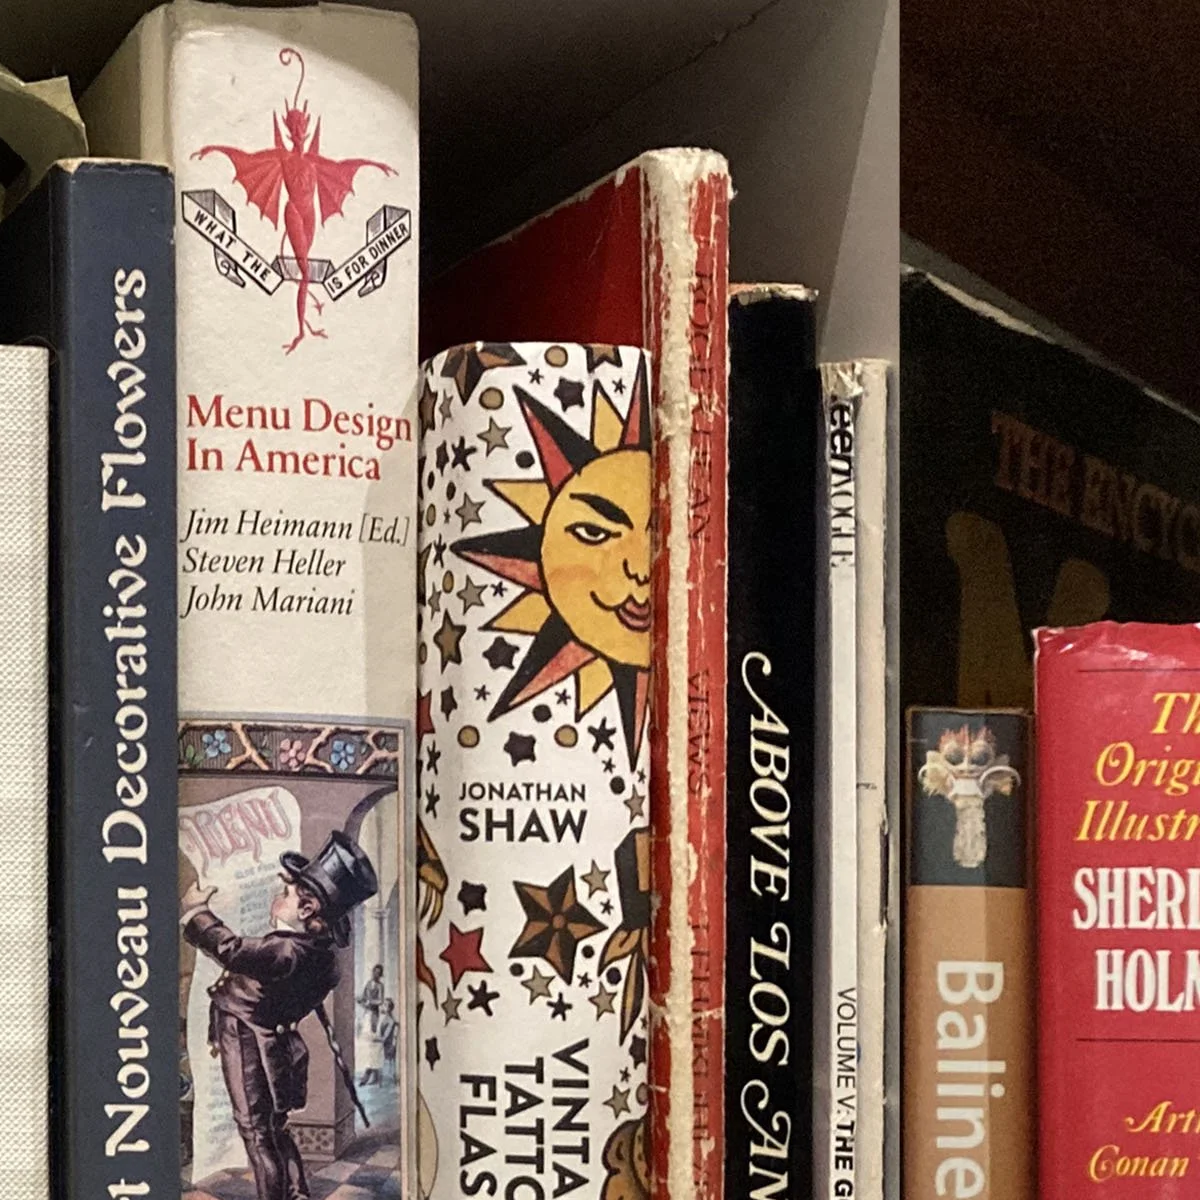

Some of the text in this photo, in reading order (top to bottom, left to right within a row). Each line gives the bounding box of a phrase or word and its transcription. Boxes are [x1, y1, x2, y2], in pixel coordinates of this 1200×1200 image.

[194, 208, 272, 283] WHAT THE
[326, 222, 410, 295] IS FOR DINNER
[100, 266, 148, 513] Flowers
[185, 393, 413, 451] Menu Design
[185, 437, 382, 481] In America
[179, 507, 411, 547] Jim Heimann [Ed.]
[181, 546, 347, 577] Steven Heller
[179, 582, 356, 620] John Mariani
[101, 532, 150, 866] Decorative
[458, 781, 587, 803] JONATHAN
[740, 651, 791, 902] ABOVE
[458, 808, 588, 844] SHAW
[103, 884, 151, 1157] Nouveau
[748, 921, 792, 1067] LOS
[836, 987, 857, 1088] VOLUME
[1124, 1100, 1200, 1134] Art
[833, 1120, 855, 1171] THE
[1089, 1143, 1190, 1183] Conan
